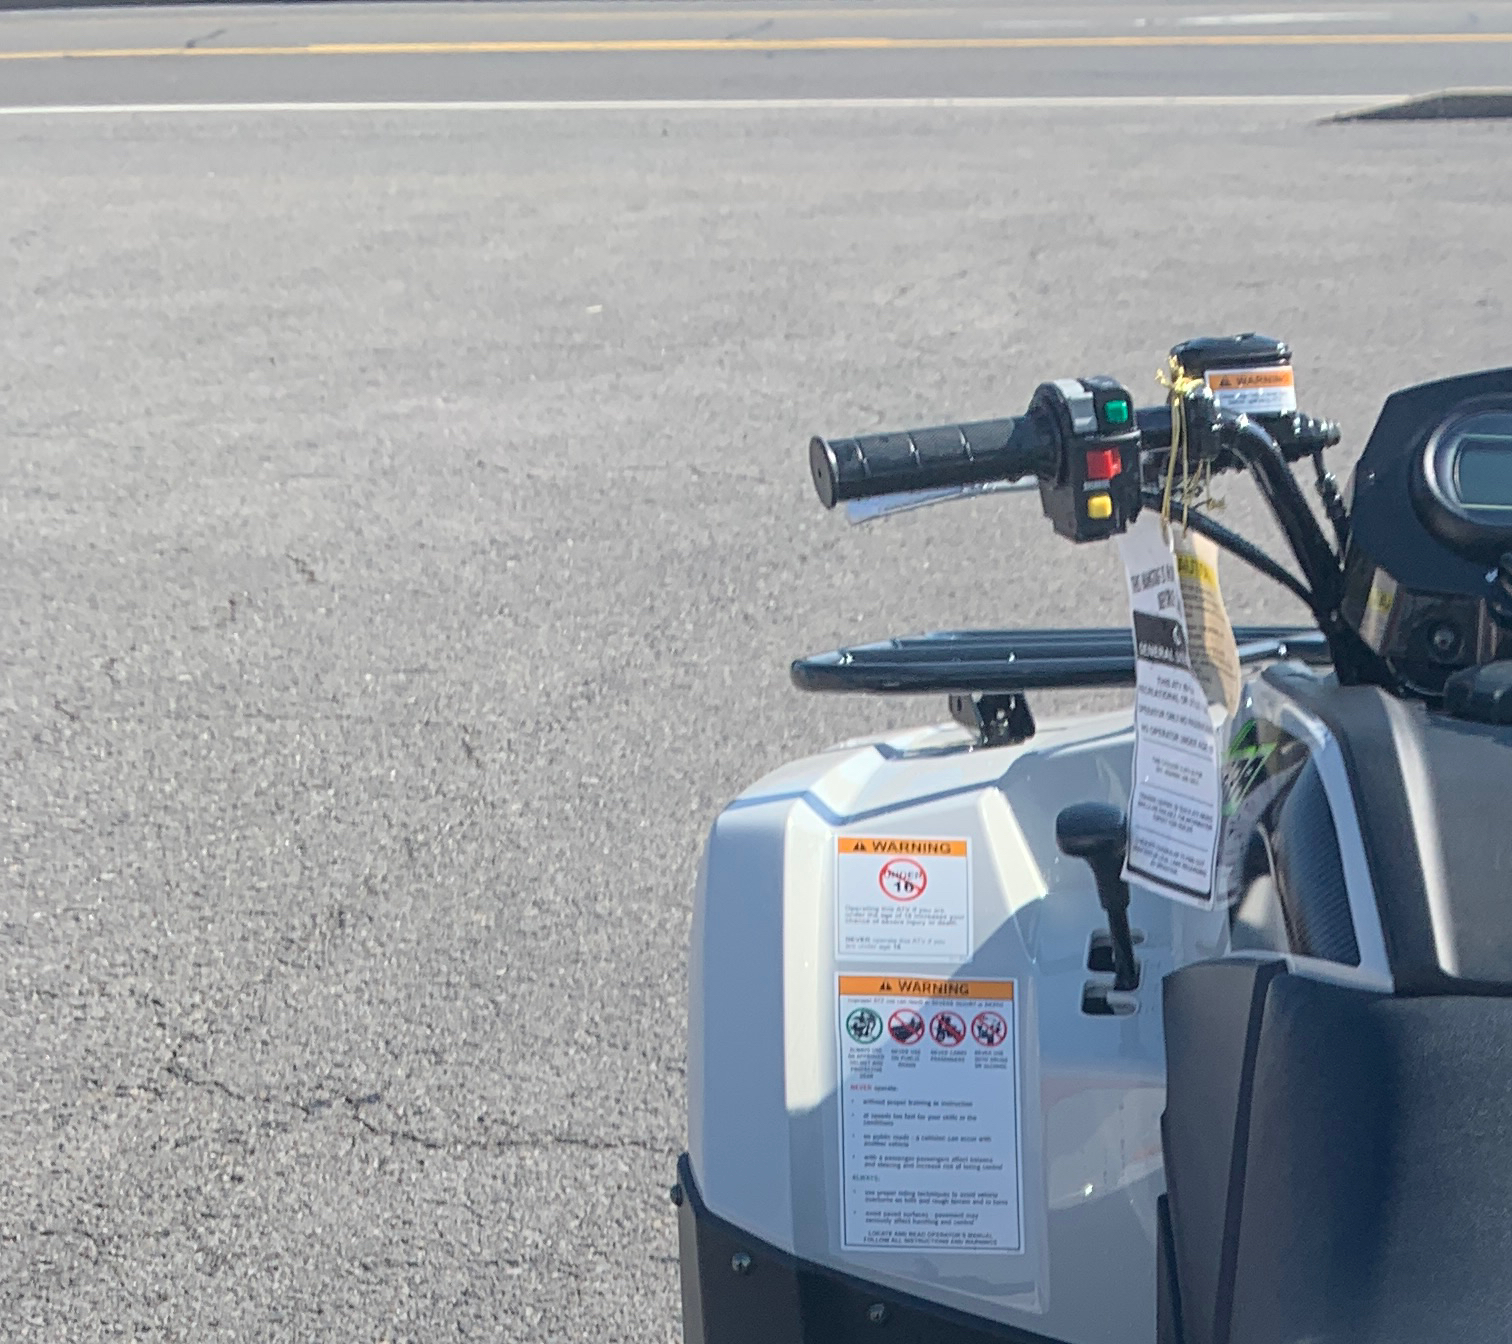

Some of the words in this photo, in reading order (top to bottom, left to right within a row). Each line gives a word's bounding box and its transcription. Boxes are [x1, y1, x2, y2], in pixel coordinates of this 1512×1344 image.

[1237, 374, 1289, 384] WARNING
[872, 841, 951, 854] WARNING
[899, 981, 969, 995] WARNING
